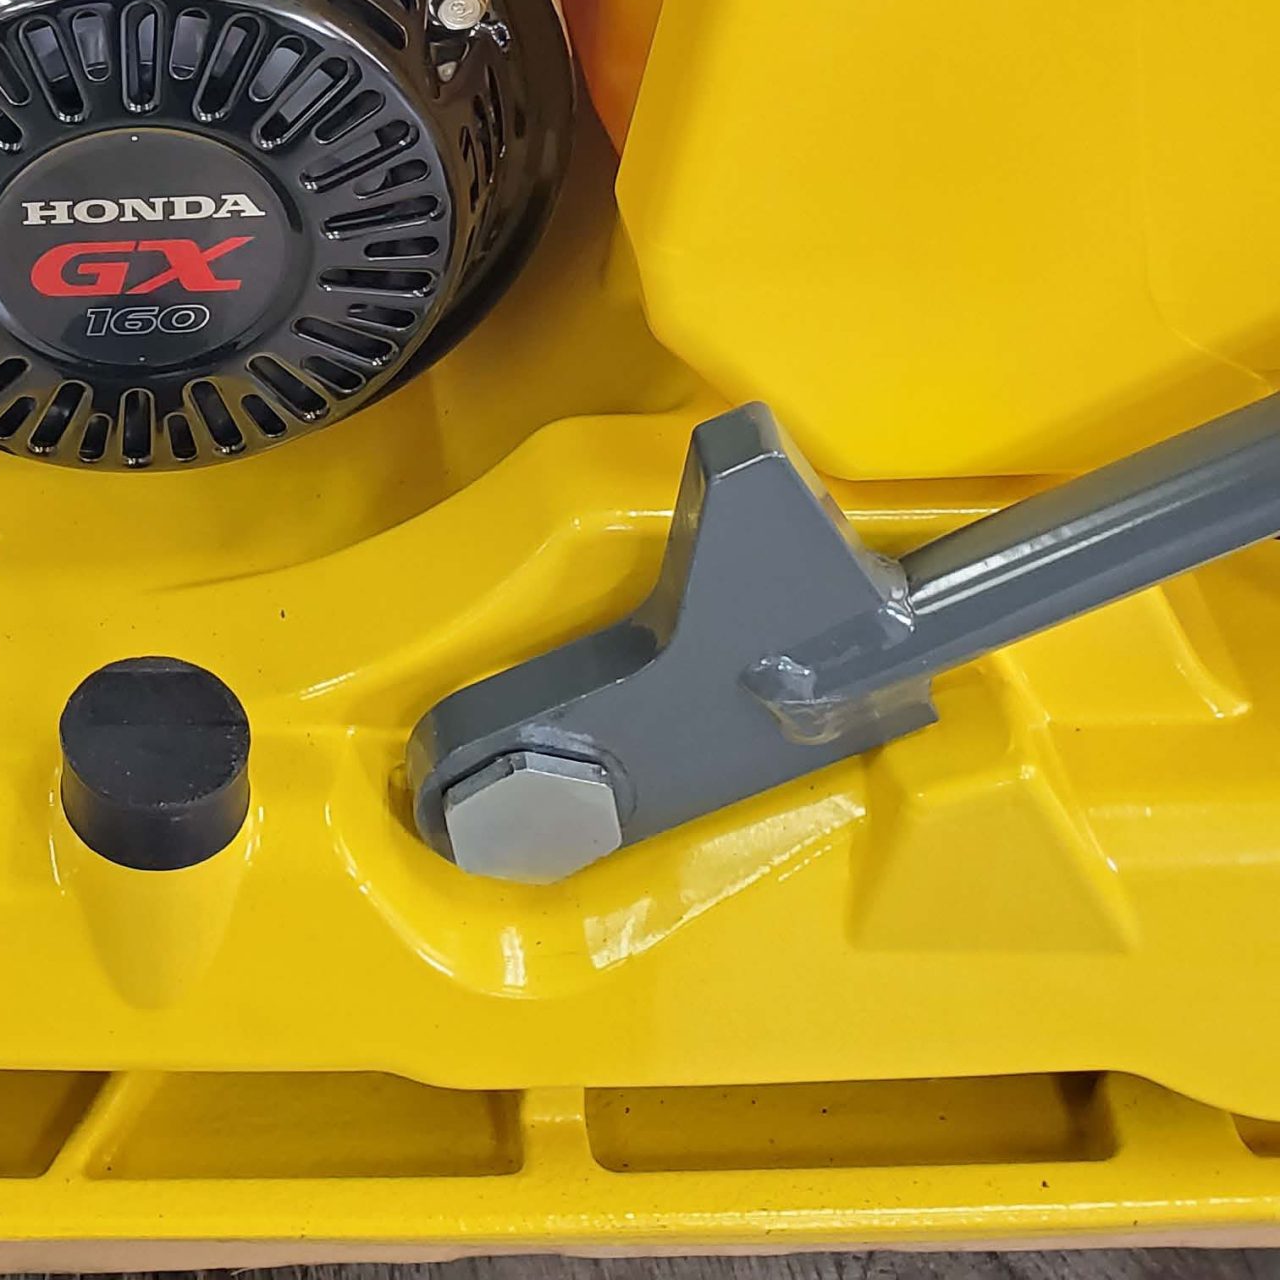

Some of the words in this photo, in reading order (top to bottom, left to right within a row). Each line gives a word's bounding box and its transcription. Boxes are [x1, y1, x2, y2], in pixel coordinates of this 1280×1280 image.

[22, 194, 266, 226] HONDA
[30, 236, 255, 297] GX
[86, 304, 210, 336] 160
